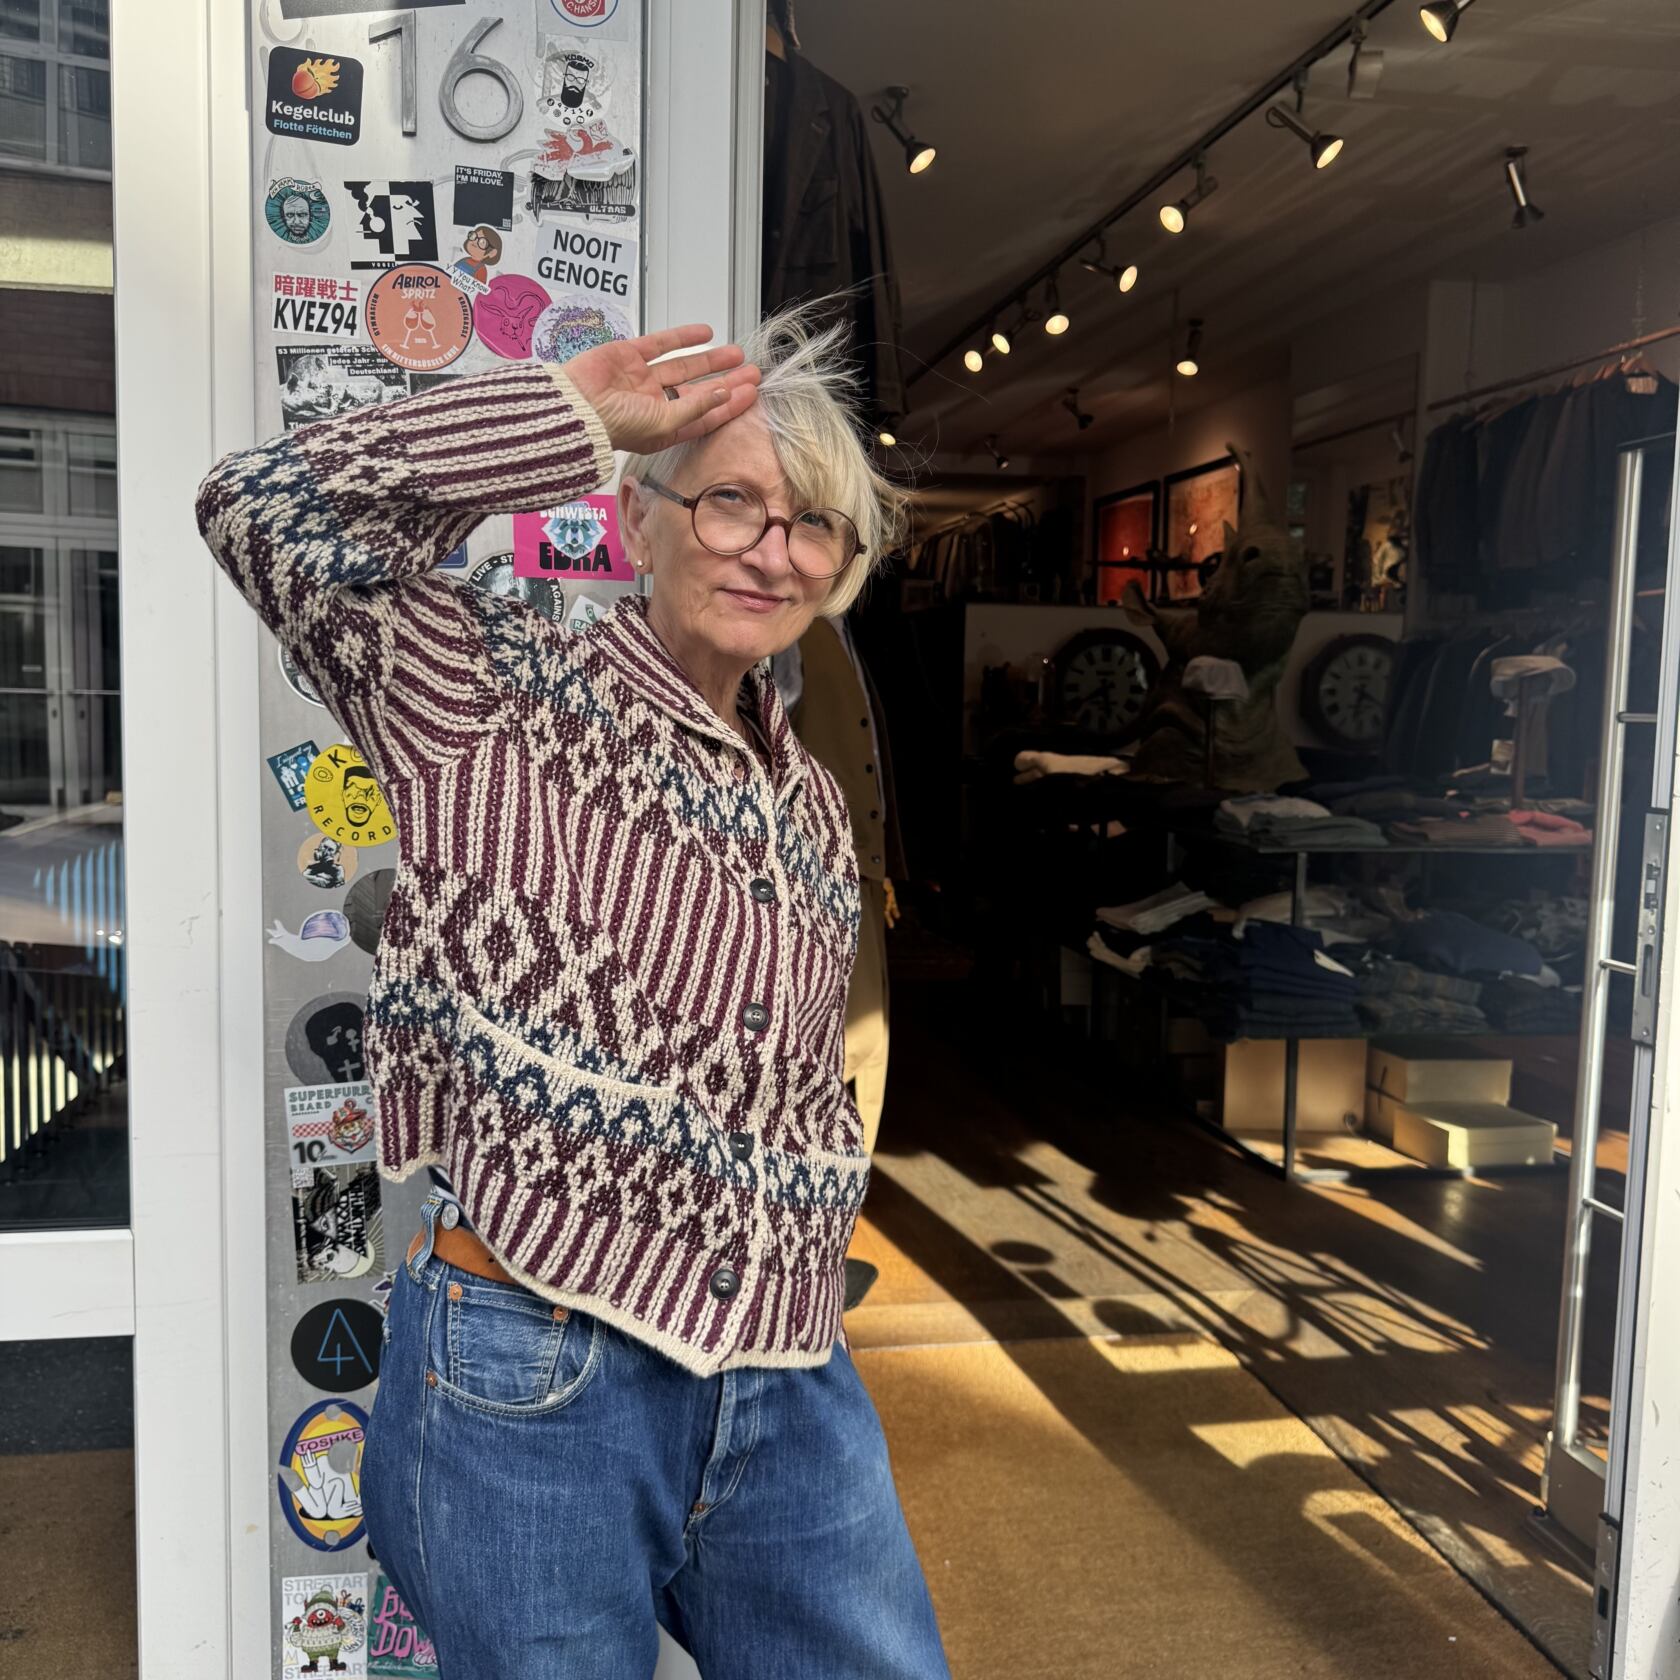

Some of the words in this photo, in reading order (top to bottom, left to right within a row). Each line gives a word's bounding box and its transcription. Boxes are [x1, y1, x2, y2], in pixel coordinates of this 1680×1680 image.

[564, 54, 594, 69] KOSMO
[368, 10, 524, 144] 16
[271, 100, 355, 126] Kegelclub
[273, 119, 304, 132] Flotte
[305, 124, 352, 139] Föttchen
[473, 169, 503, 180] FRIDAY,
[480, 178, 504, 186] LOVE.
[589, 205, 626, 214] ULTRAS
[553, 229, 622, 264] NOOIT
[392, 273, 441, 290] ABIROL
[452, 276, 476, 293] What?
[537, 256, 628, 296] GENOEG
[401, 288, 436, 300] SPRITZ
[273, 298, 357, 336] KVEZ94
[290, 347, 325, 355] Millionen
[352, 357, 370, 365] Jahr
[350, 367, 399, 375] Deutschland!
[472, 561, 492, 582] LIVE
[550, 584, 563, 621] AGAINS
[289, 1085, 372, 1102] SUPERFURR
[291, 1101, 332, 1112] BEARD
[293, 1139, 326, 1164] 10
[299, 1430, 361, 1452] TOSHKE
